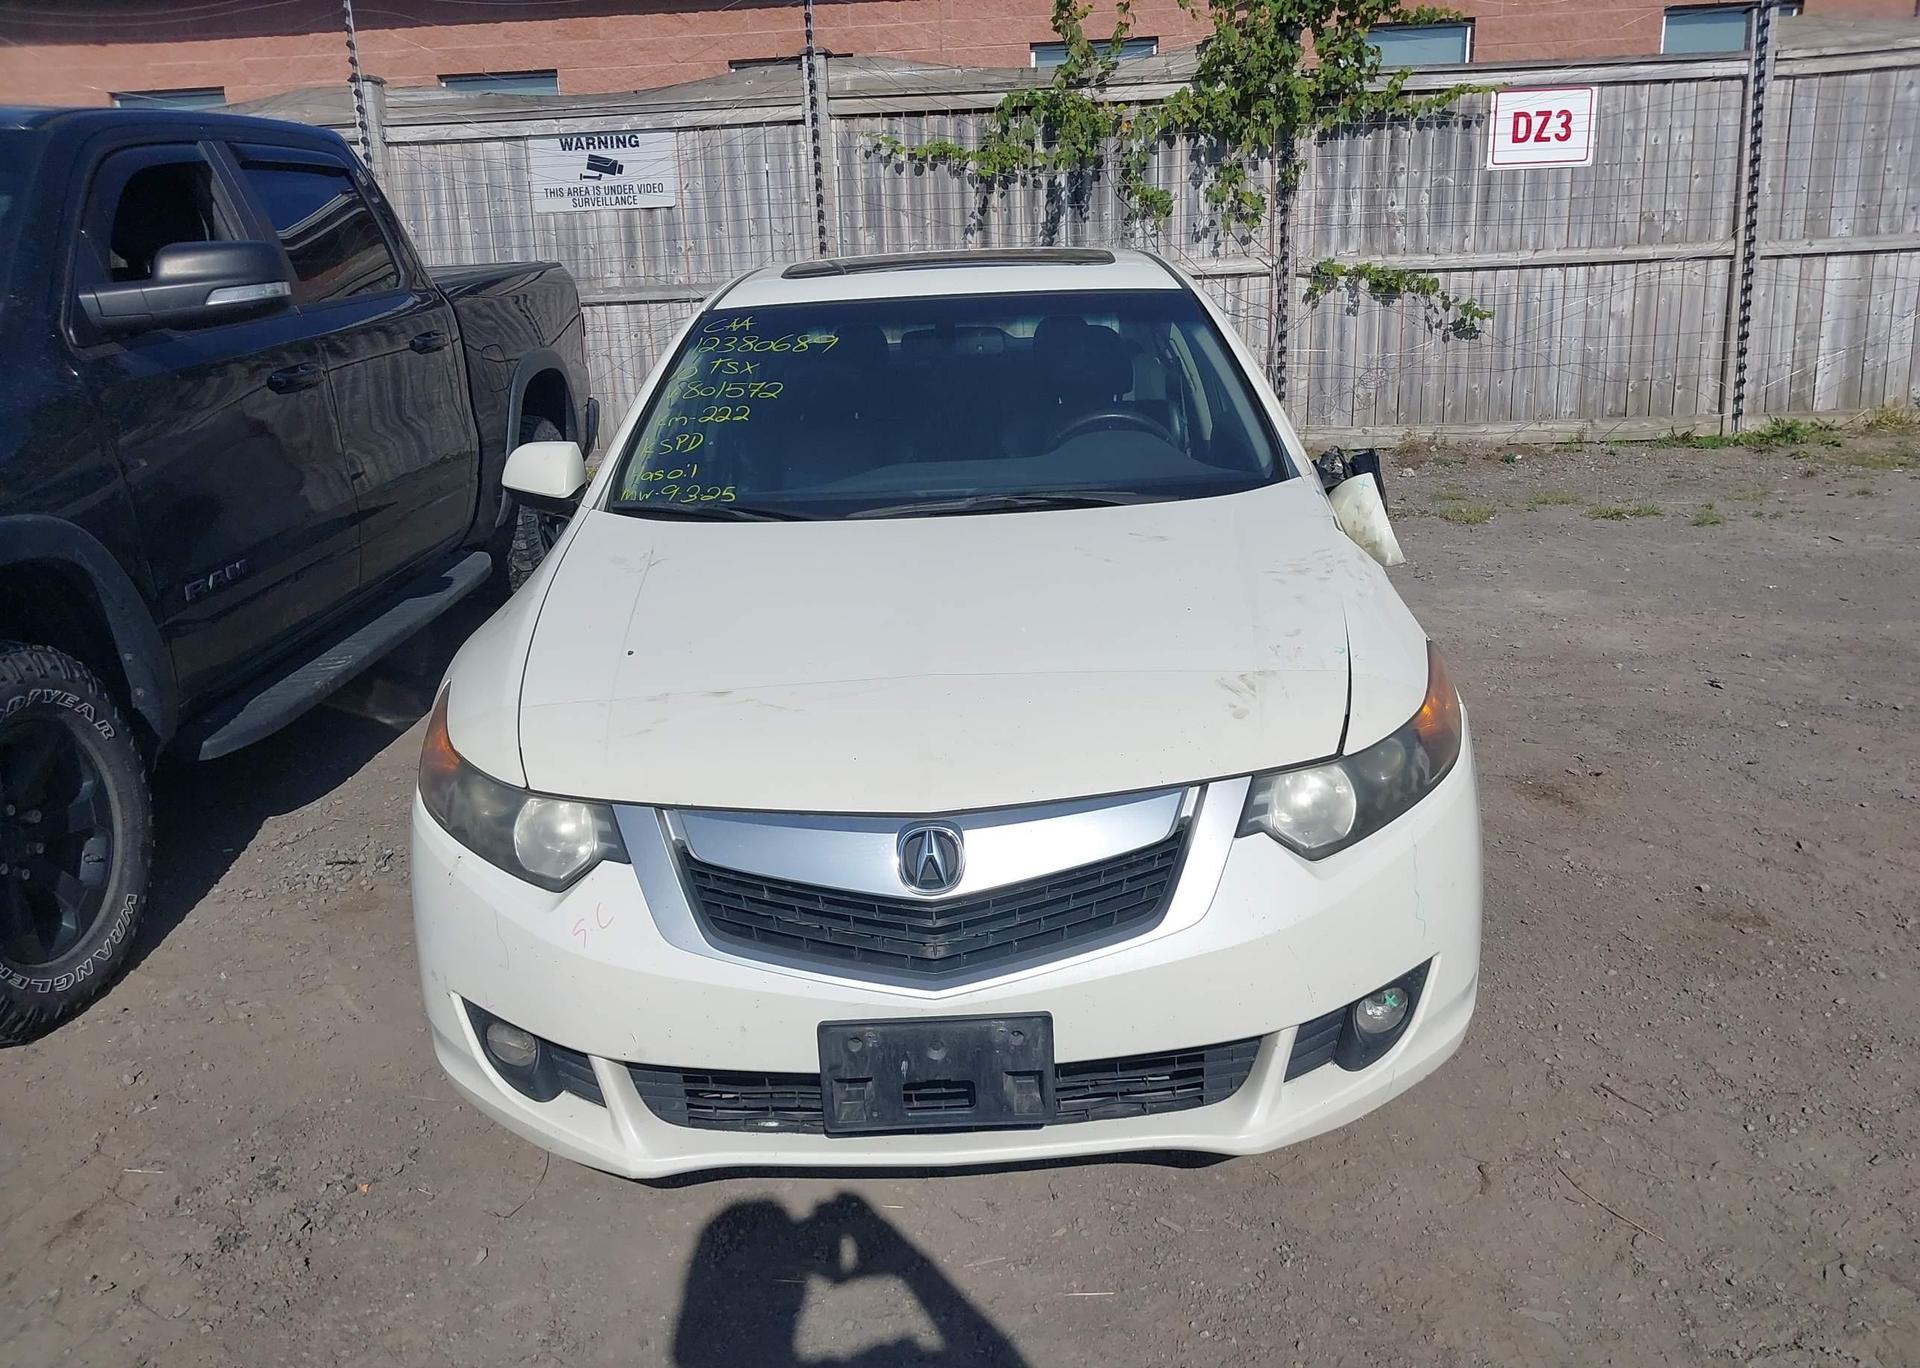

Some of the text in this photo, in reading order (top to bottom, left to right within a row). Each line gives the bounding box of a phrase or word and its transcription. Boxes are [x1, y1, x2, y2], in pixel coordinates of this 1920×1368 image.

[1511, 109, 1573, 144] DZ3
[559, 134, 640, 151] WARNING
[544, 182, 664, 198] THIS AREA IS UNDER VIDEO
[572, 194, 638, 208] SURVEILLANCE
[710, 358, 760, 374] TSX
